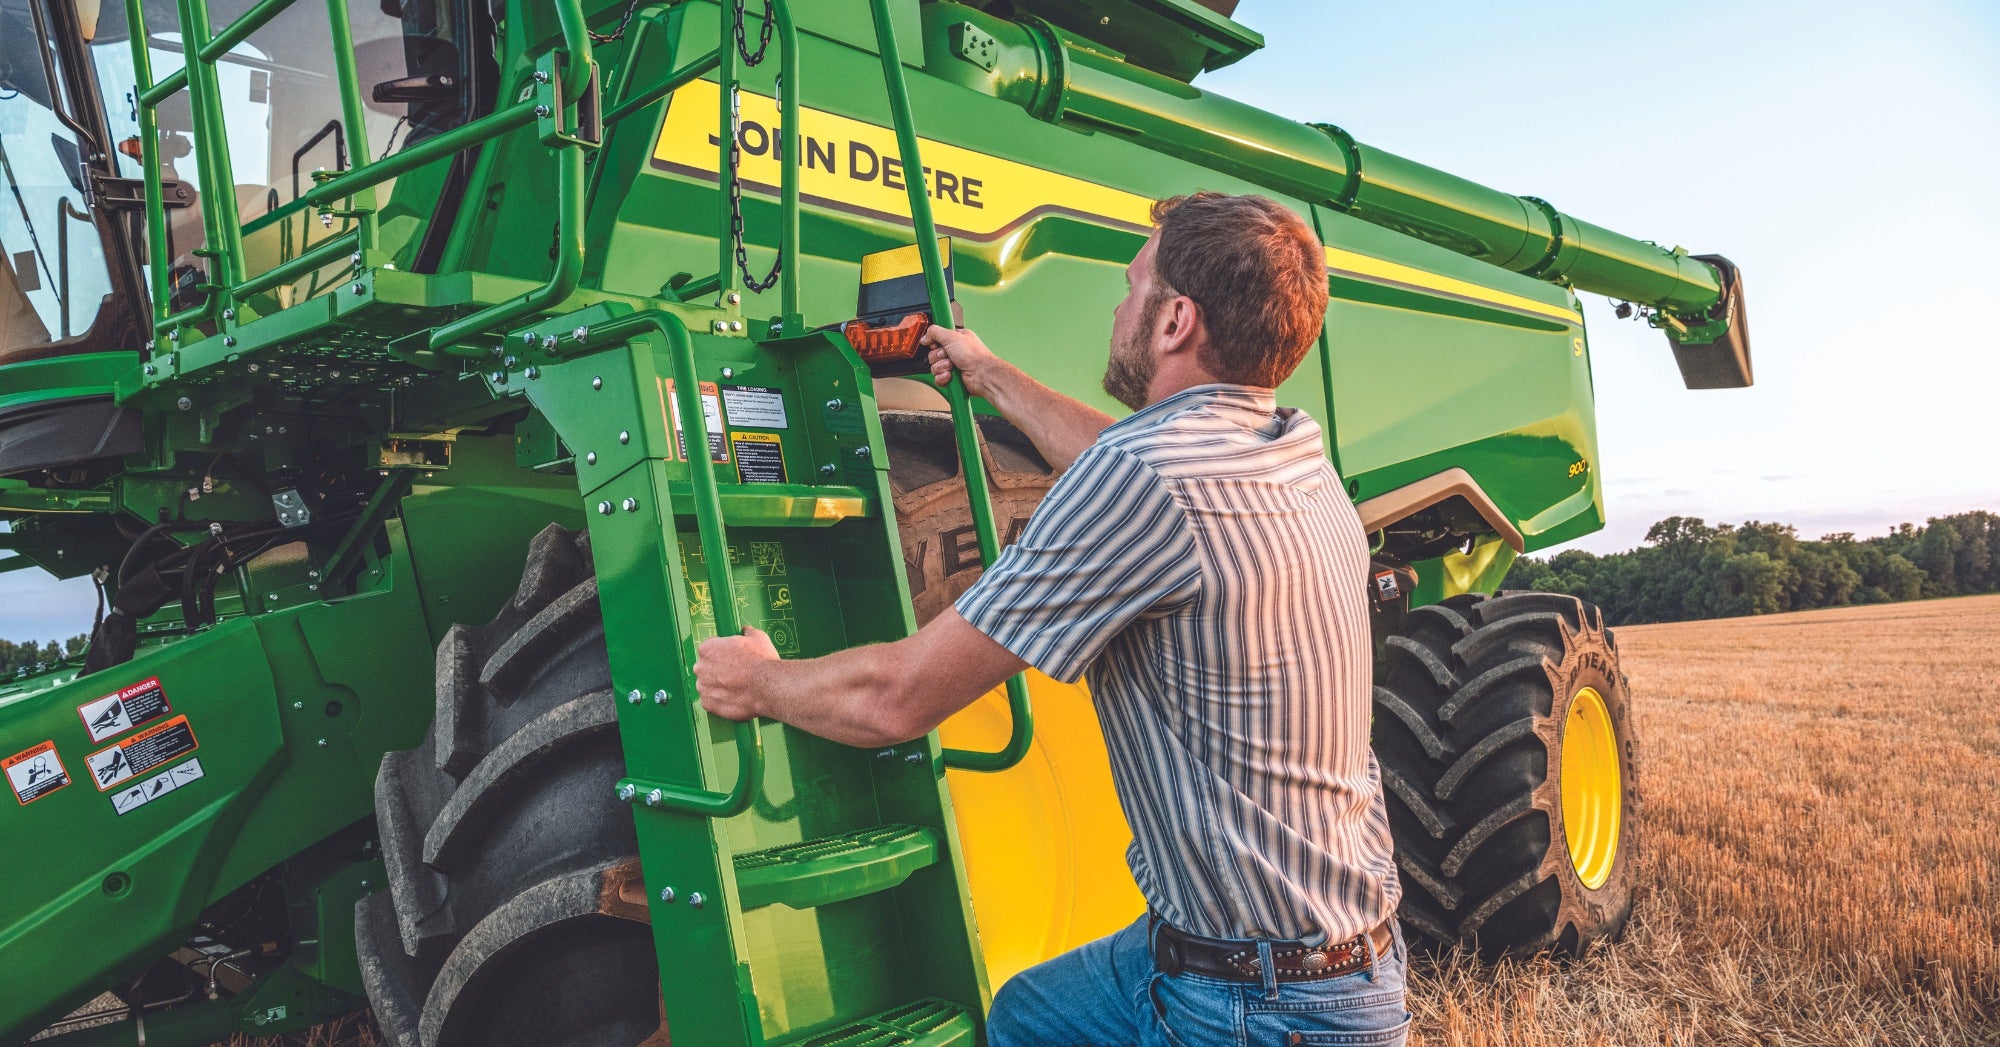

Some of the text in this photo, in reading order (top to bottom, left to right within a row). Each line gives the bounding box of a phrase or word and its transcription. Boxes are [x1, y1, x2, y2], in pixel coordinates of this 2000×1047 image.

[1568, 458, 1586, 478] 900
[126, 679, 157, 698] DANGER
[137, 721, 170, 740] WARNING
[14, 743, 48, 761] WARNING
